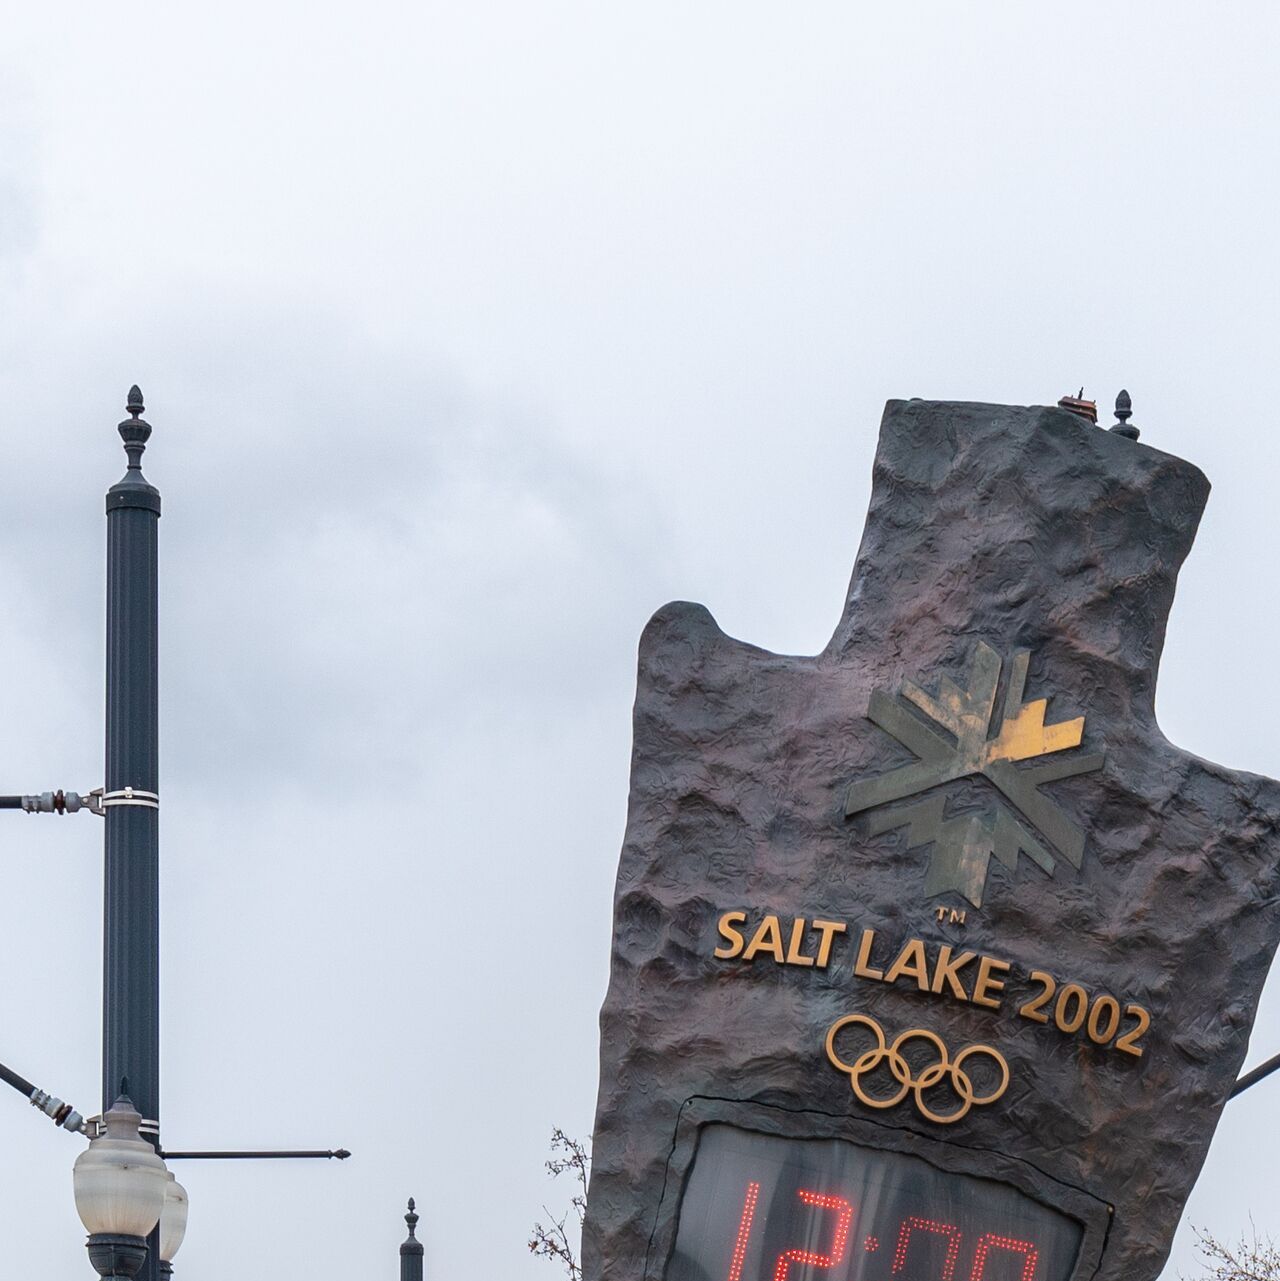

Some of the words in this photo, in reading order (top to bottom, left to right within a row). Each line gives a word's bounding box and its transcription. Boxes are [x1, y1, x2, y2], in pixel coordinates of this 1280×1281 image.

[935, 906, 967, 925] TM
[713, 910, 847, 968] SALT
[854, 929, 1011, 1009] LAKE
[1018, 971, 1152, 1057] 2002
